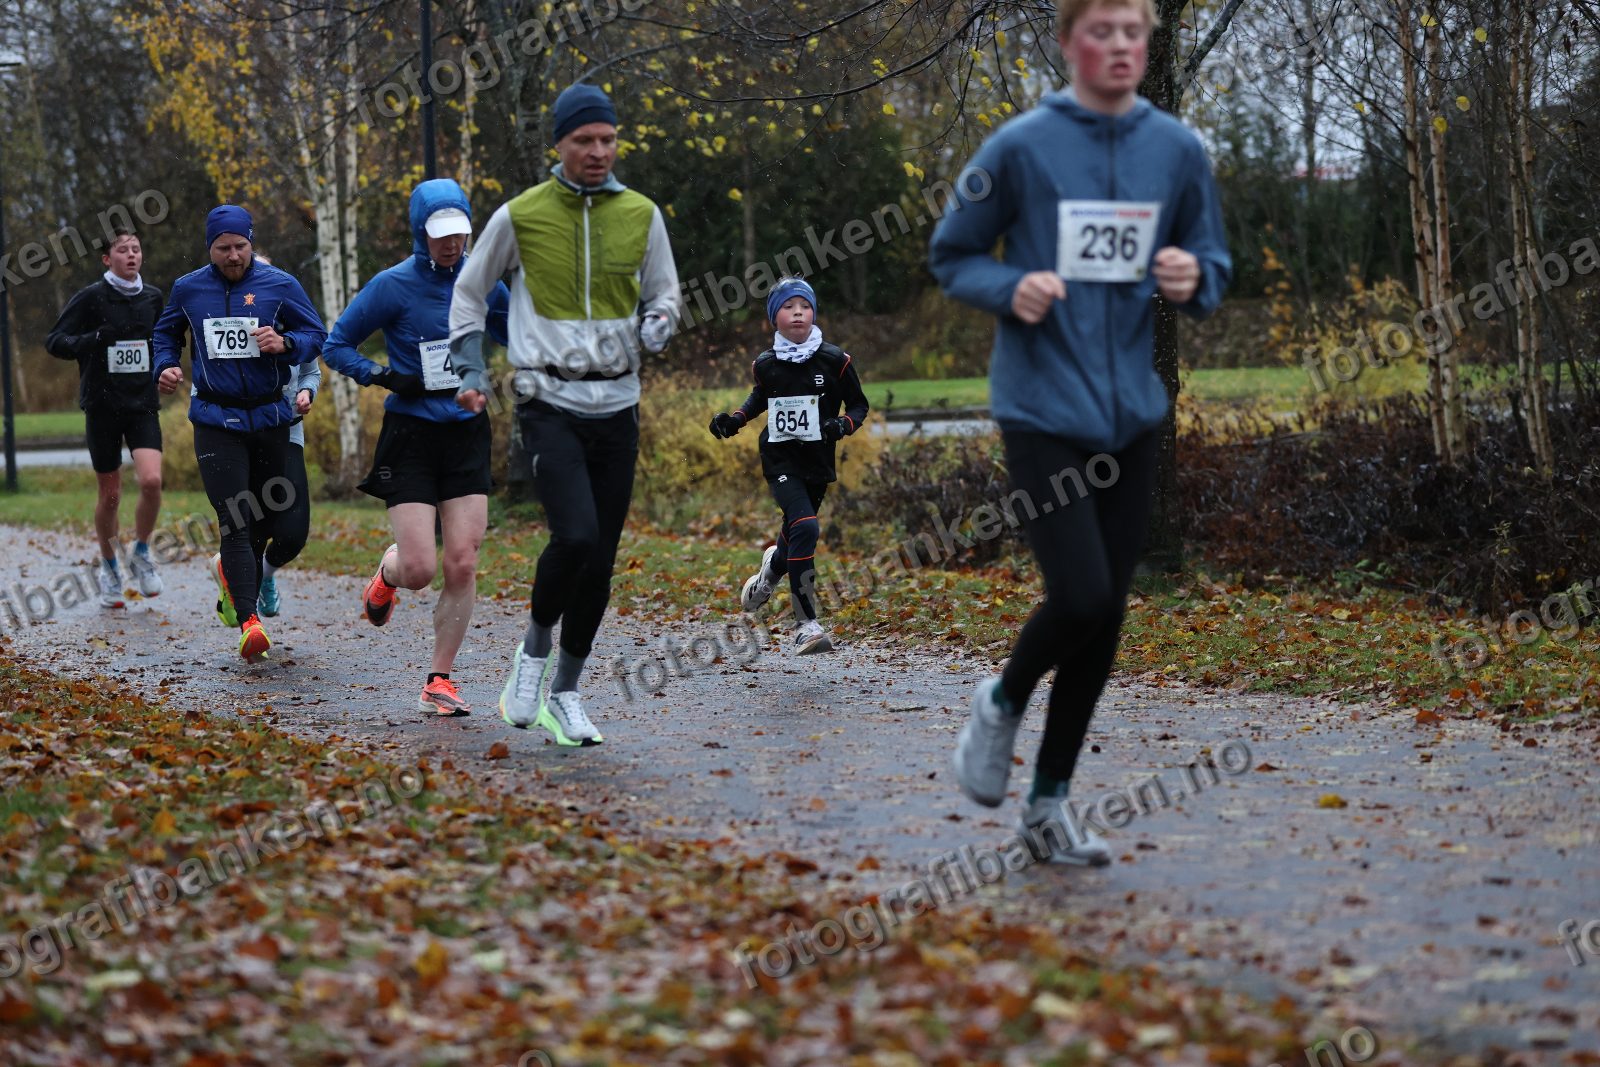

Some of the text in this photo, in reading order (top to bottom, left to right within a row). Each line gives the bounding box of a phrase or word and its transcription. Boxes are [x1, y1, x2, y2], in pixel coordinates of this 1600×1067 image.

[1079, 225, 1139, 261] 236
[214, 329, 249, 350] 769
[116, 349, 142, 365] 380
[776, 410, 810, 432] 654
